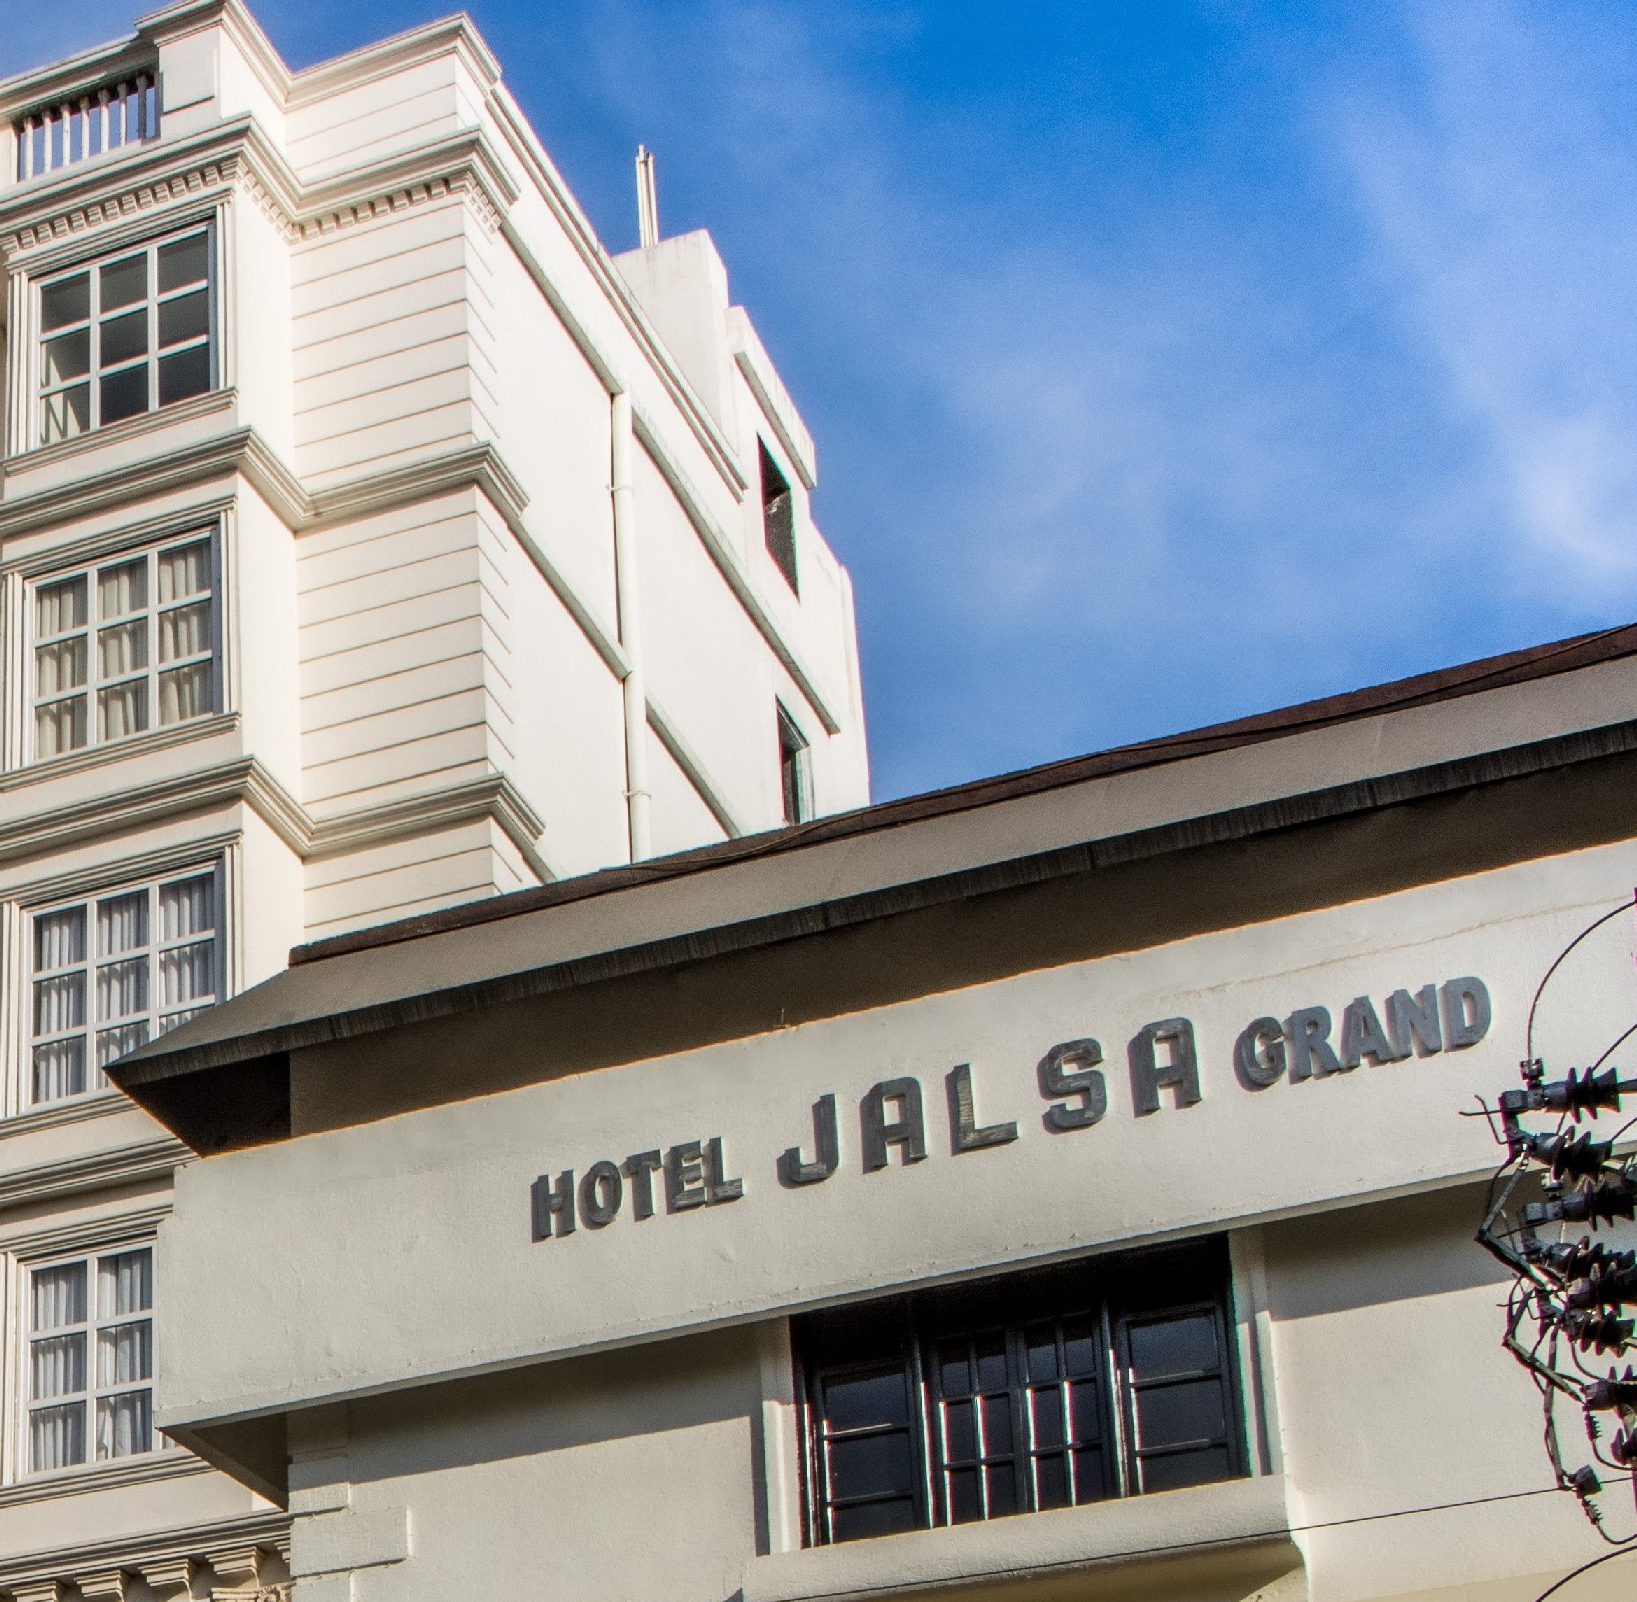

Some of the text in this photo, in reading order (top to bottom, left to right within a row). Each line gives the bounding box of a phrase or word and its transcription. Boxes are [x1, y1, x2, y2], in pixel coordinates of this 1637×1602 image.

[532, 976, 1492, 1243] HOTEL JALSA GRAND
